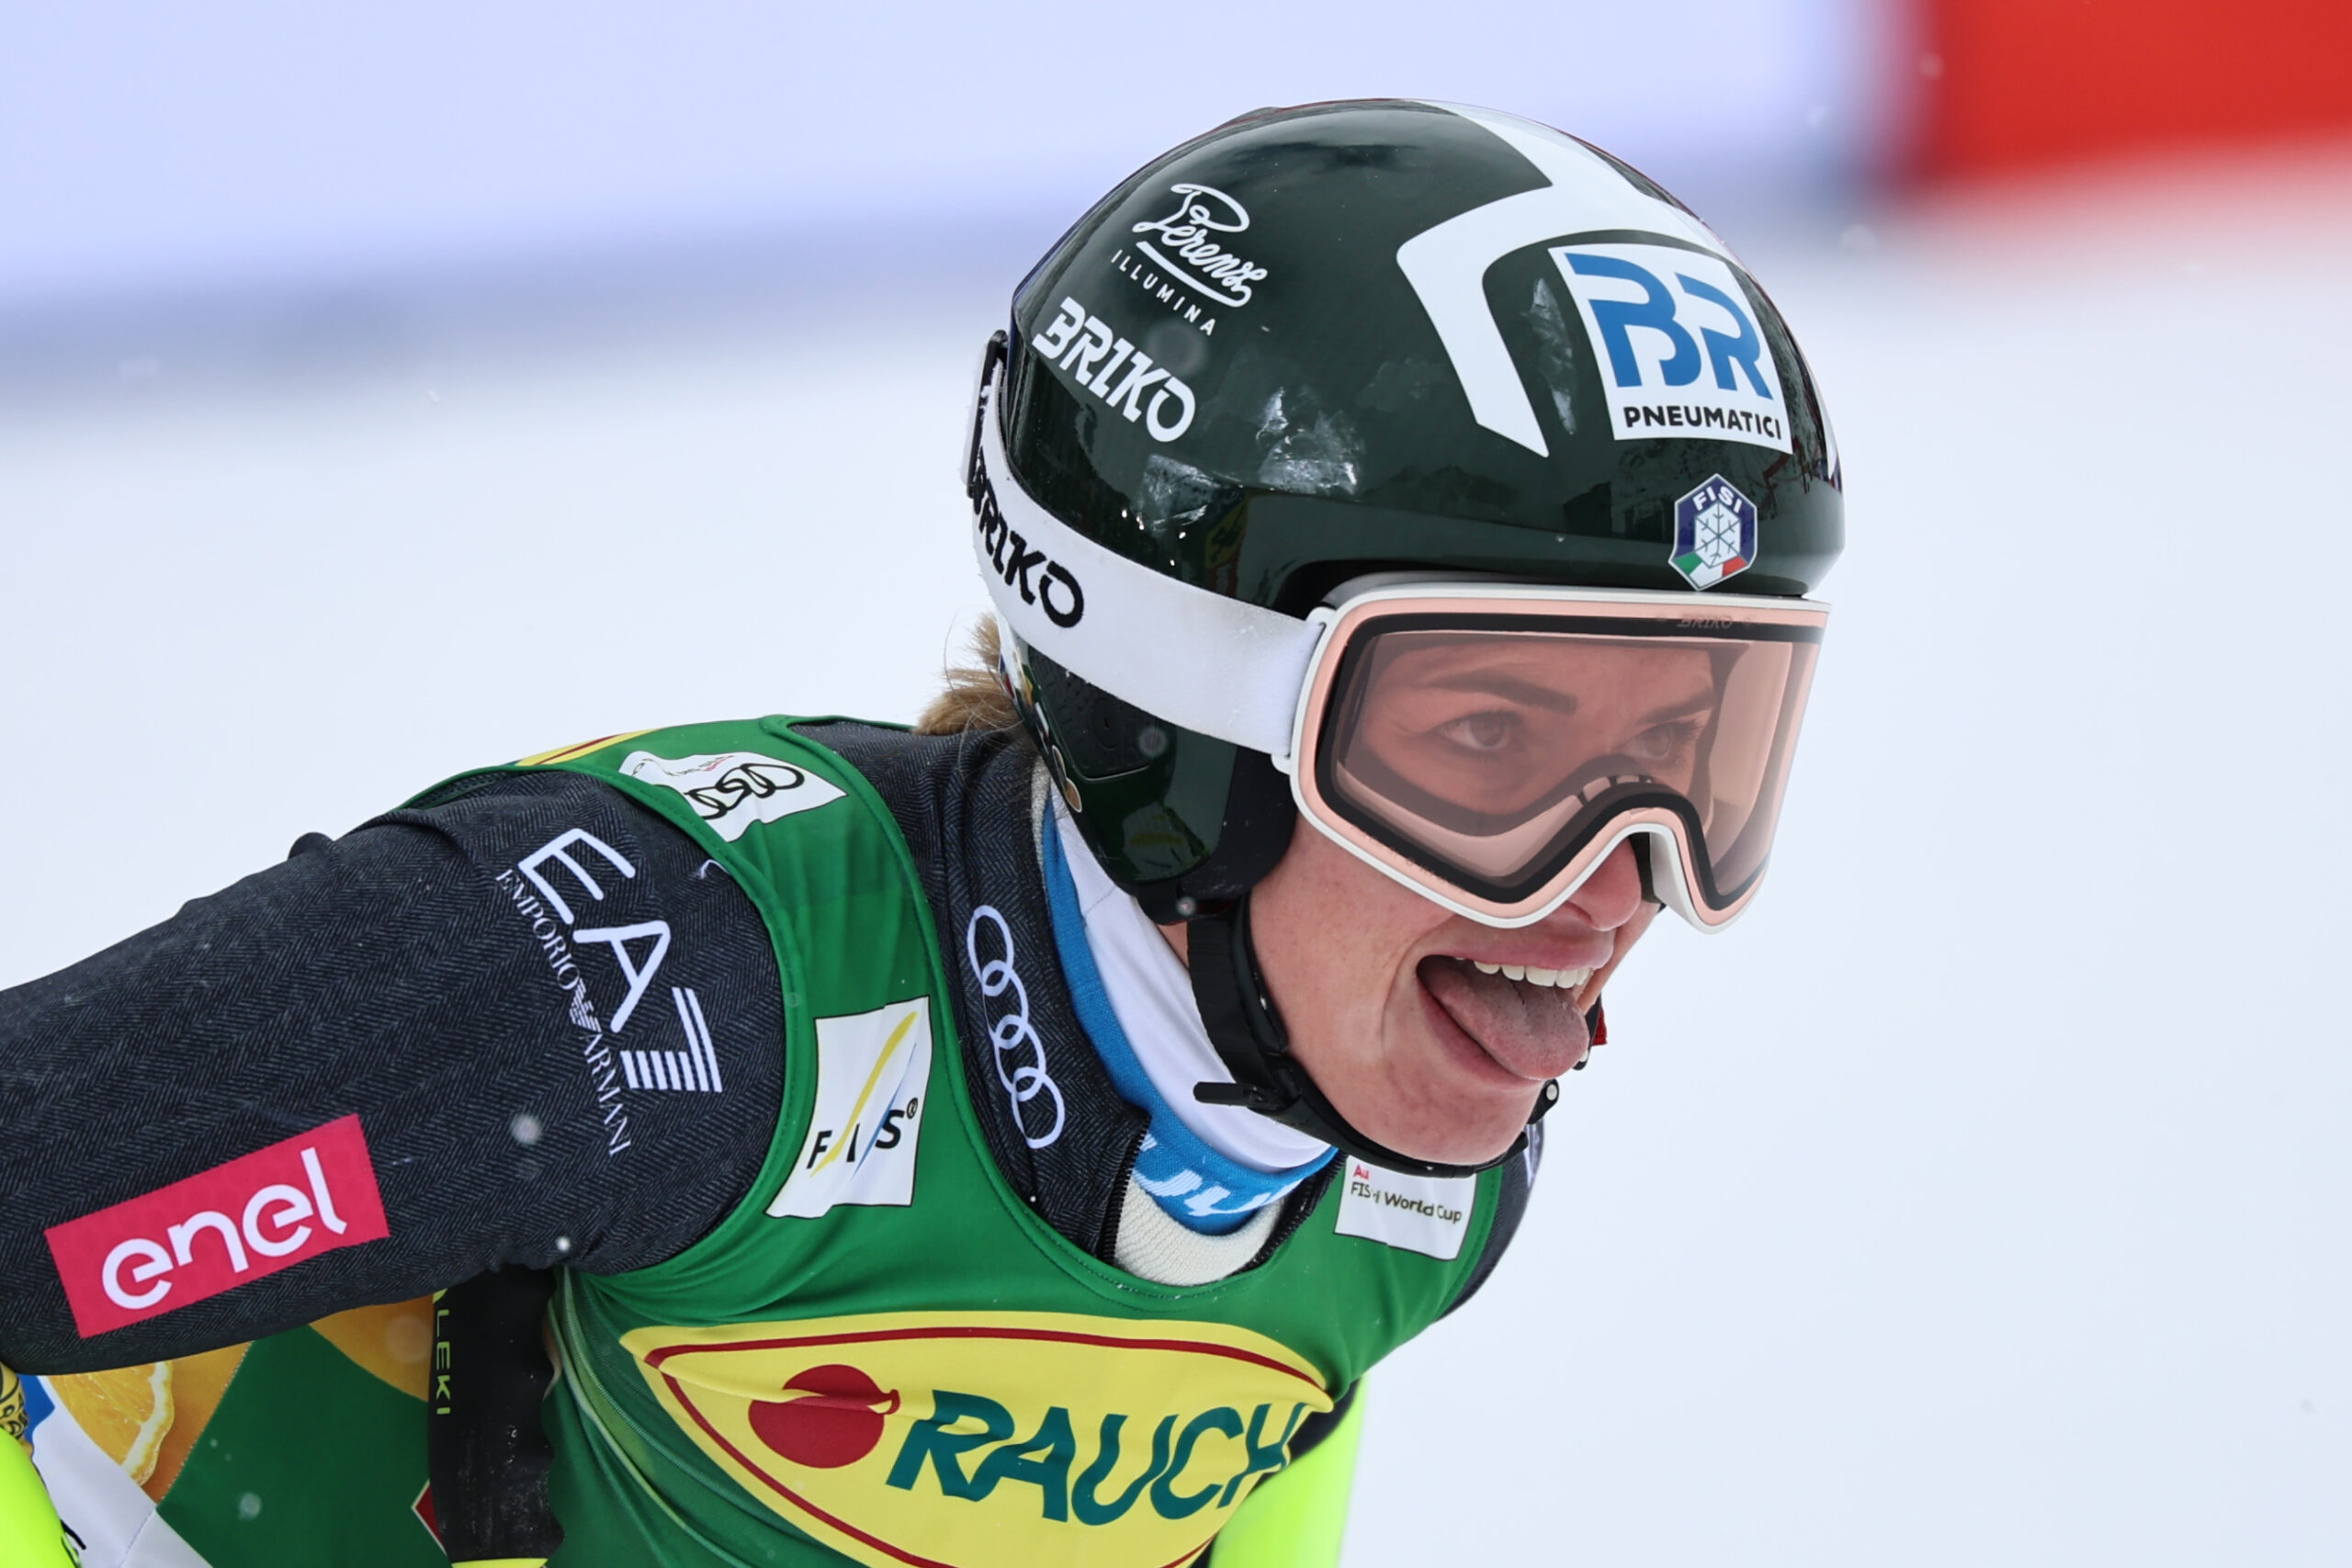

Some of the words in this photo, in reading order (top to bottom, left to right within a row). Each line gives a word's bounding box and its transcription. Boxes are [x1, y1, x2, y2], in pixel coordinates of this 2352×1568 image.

[1110, 249, 1216, 335] ILLUMINA
[1565, 253, 1773, 400] BR
[1032, 296, 1196, 442] BRIKO
[1623, 405, 1782, 440] PNEUMATICI
[1692, 486, 1743, 513] FISI
[495, 868, 582, 991] EMPORIO
[517, 828, 723, 1093] EA7
[577, 1031, 632, 1156] ARMANI
[101, 1146, 347, 1310] enel
[1385, 1192, 1434, 1217] World
[1437, 1205, 1462, 1224] Cup
[435, 1308, 451, 1415] LEKI
[886, 1389, 1306, 1527] RAUCH
